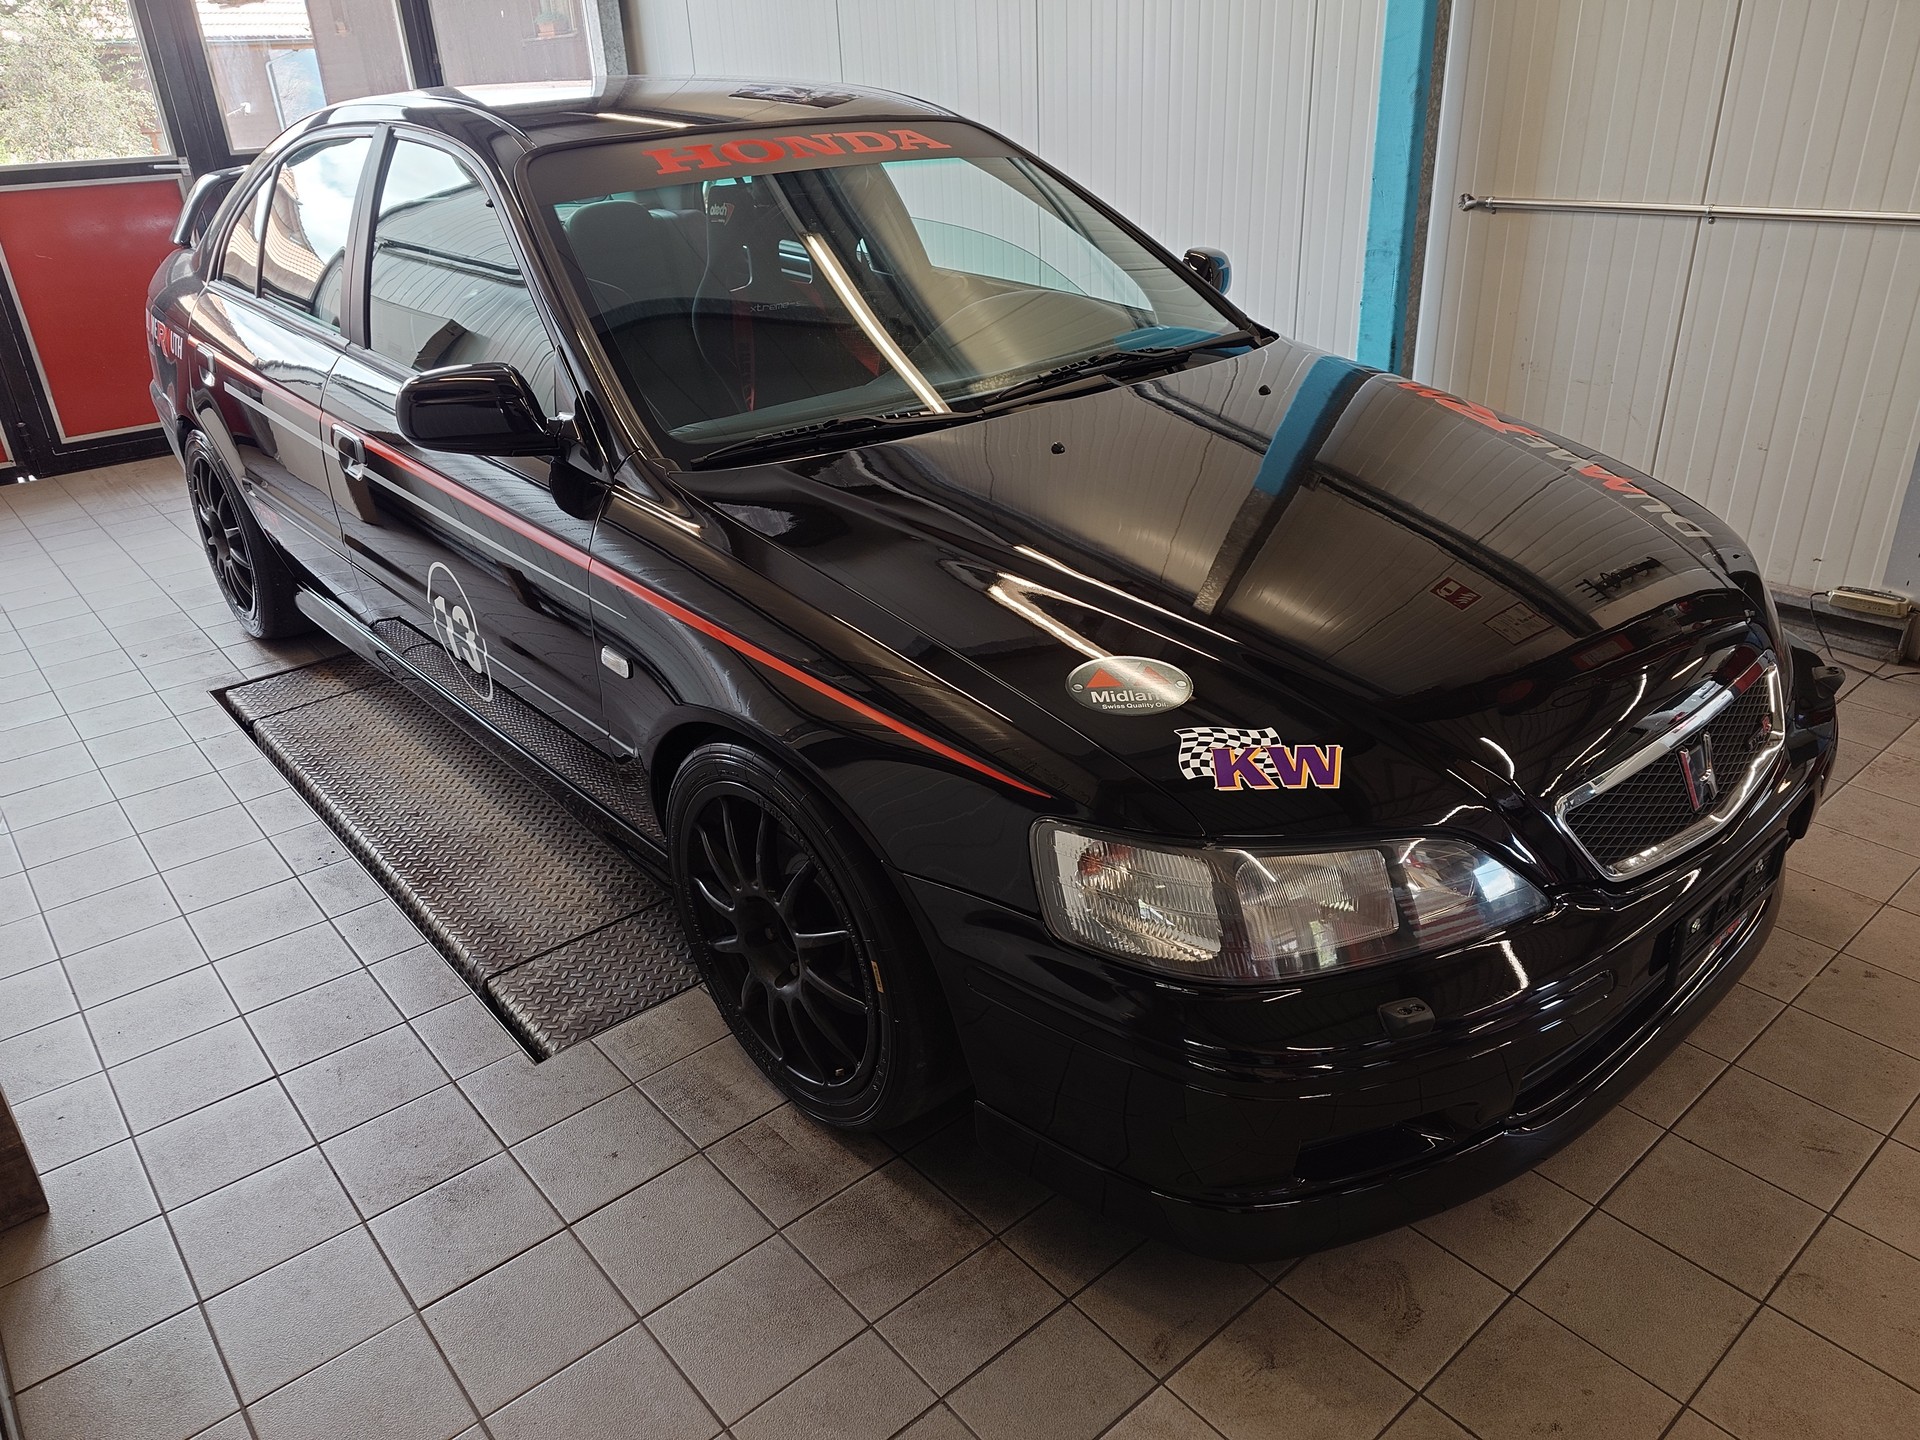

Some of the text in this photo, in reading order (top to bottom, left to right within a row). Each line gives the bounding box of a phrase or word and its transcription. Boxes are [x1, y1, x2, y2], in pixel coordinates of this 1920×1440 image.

[642, 129, 952, 175] HONDA
[434, 595, 482, 674] 13
[1090, 690, 1169, 703] Midlan
[1210, 745, 1343, 791] KW
